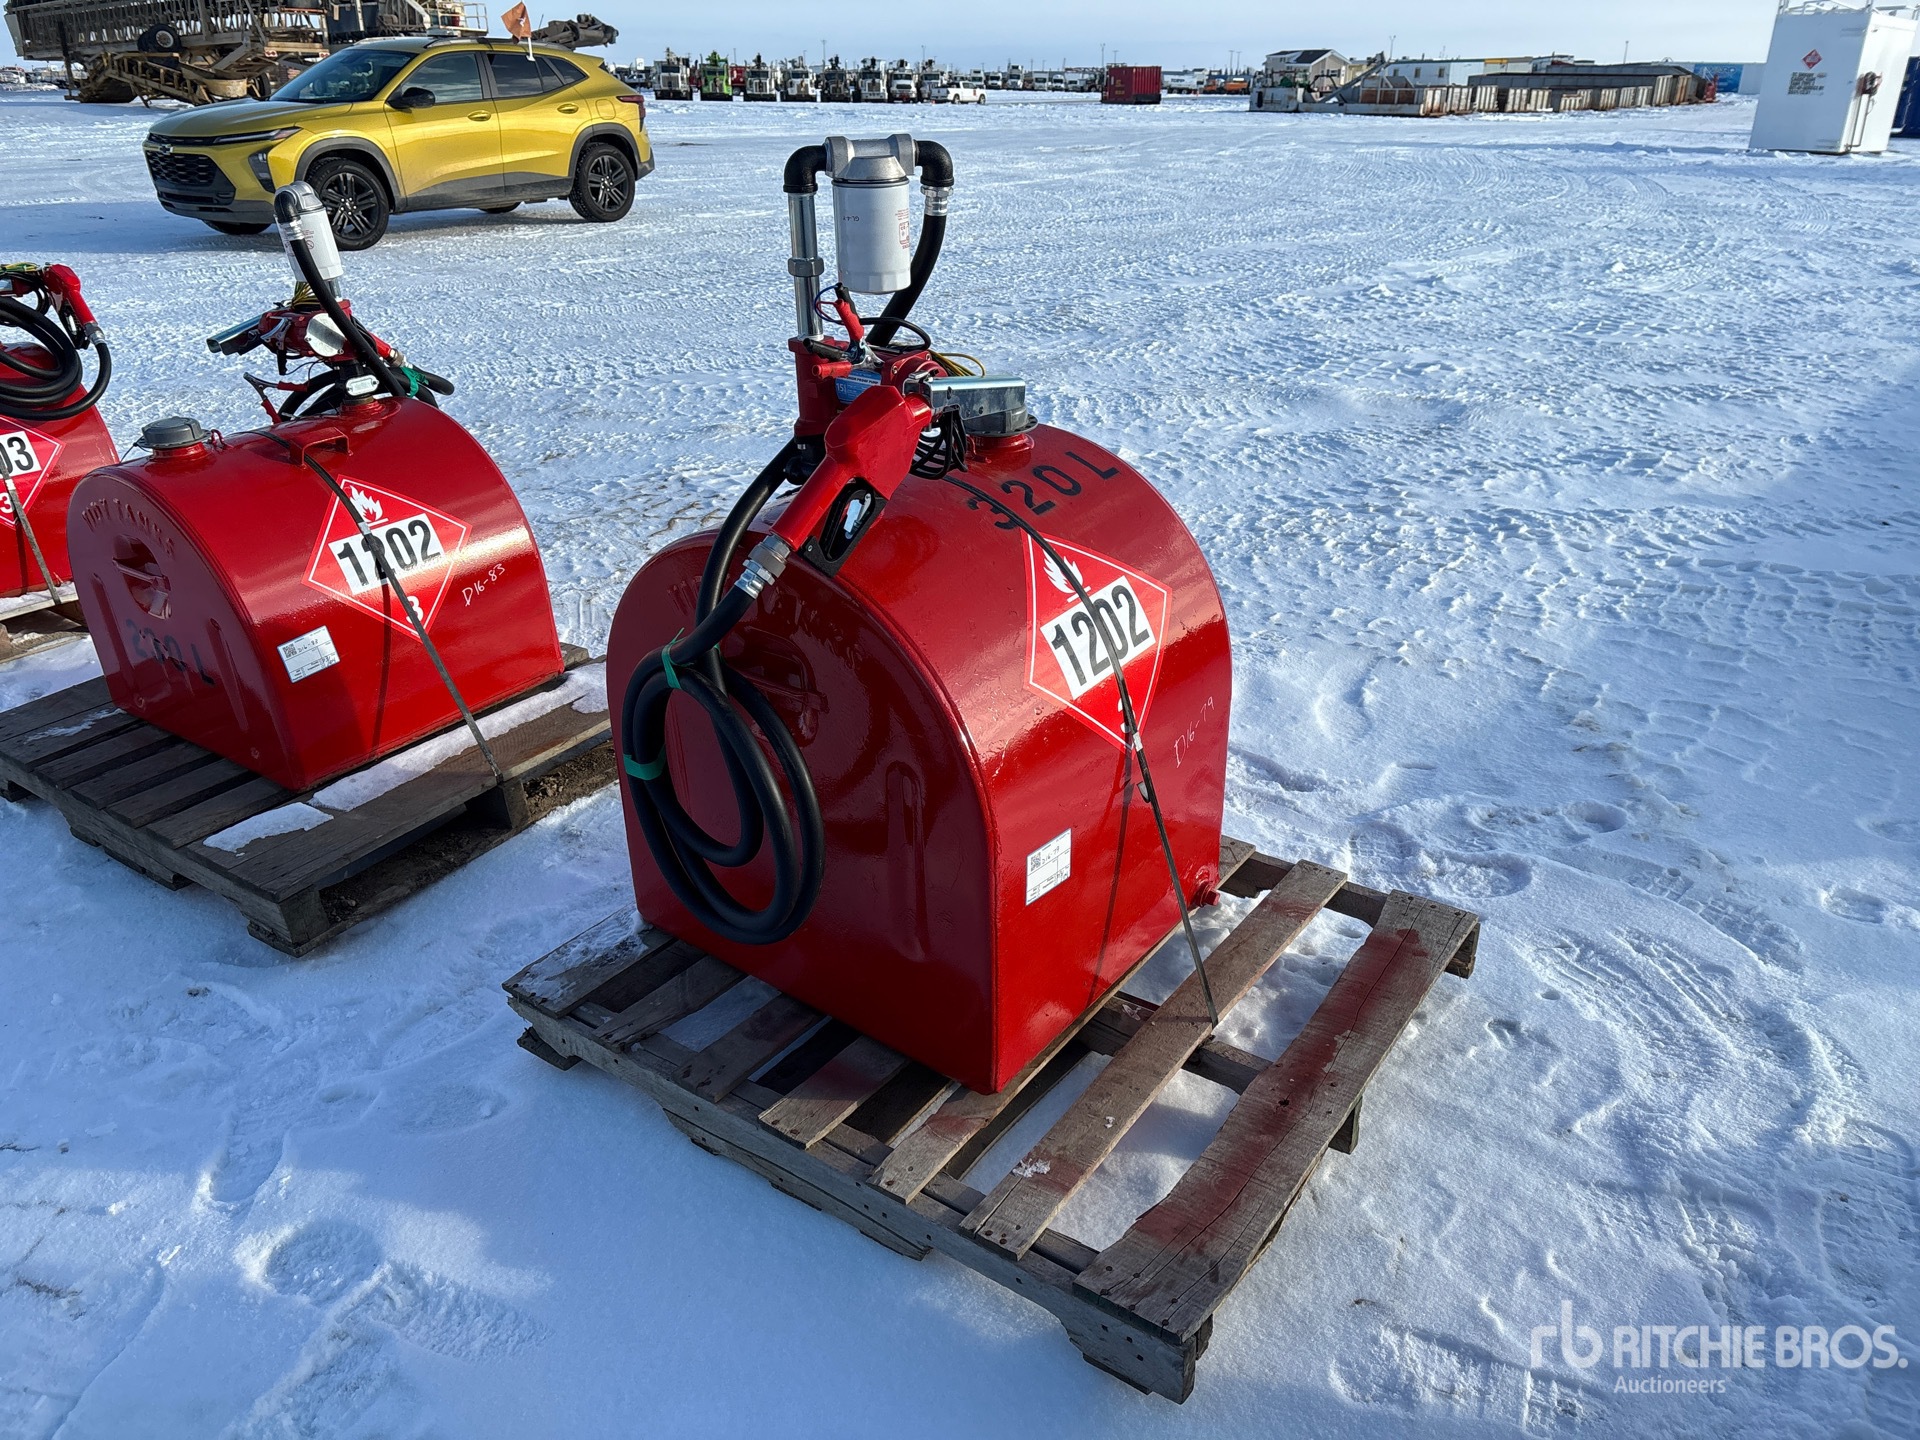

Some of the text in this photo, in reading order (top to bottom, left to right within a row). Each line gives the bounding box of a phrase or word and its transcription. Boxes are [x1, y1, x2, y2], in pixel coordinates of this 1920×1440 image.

[967, 451, 1120, 530] 320 L
[1050, 584, 1150, 687] 1202
